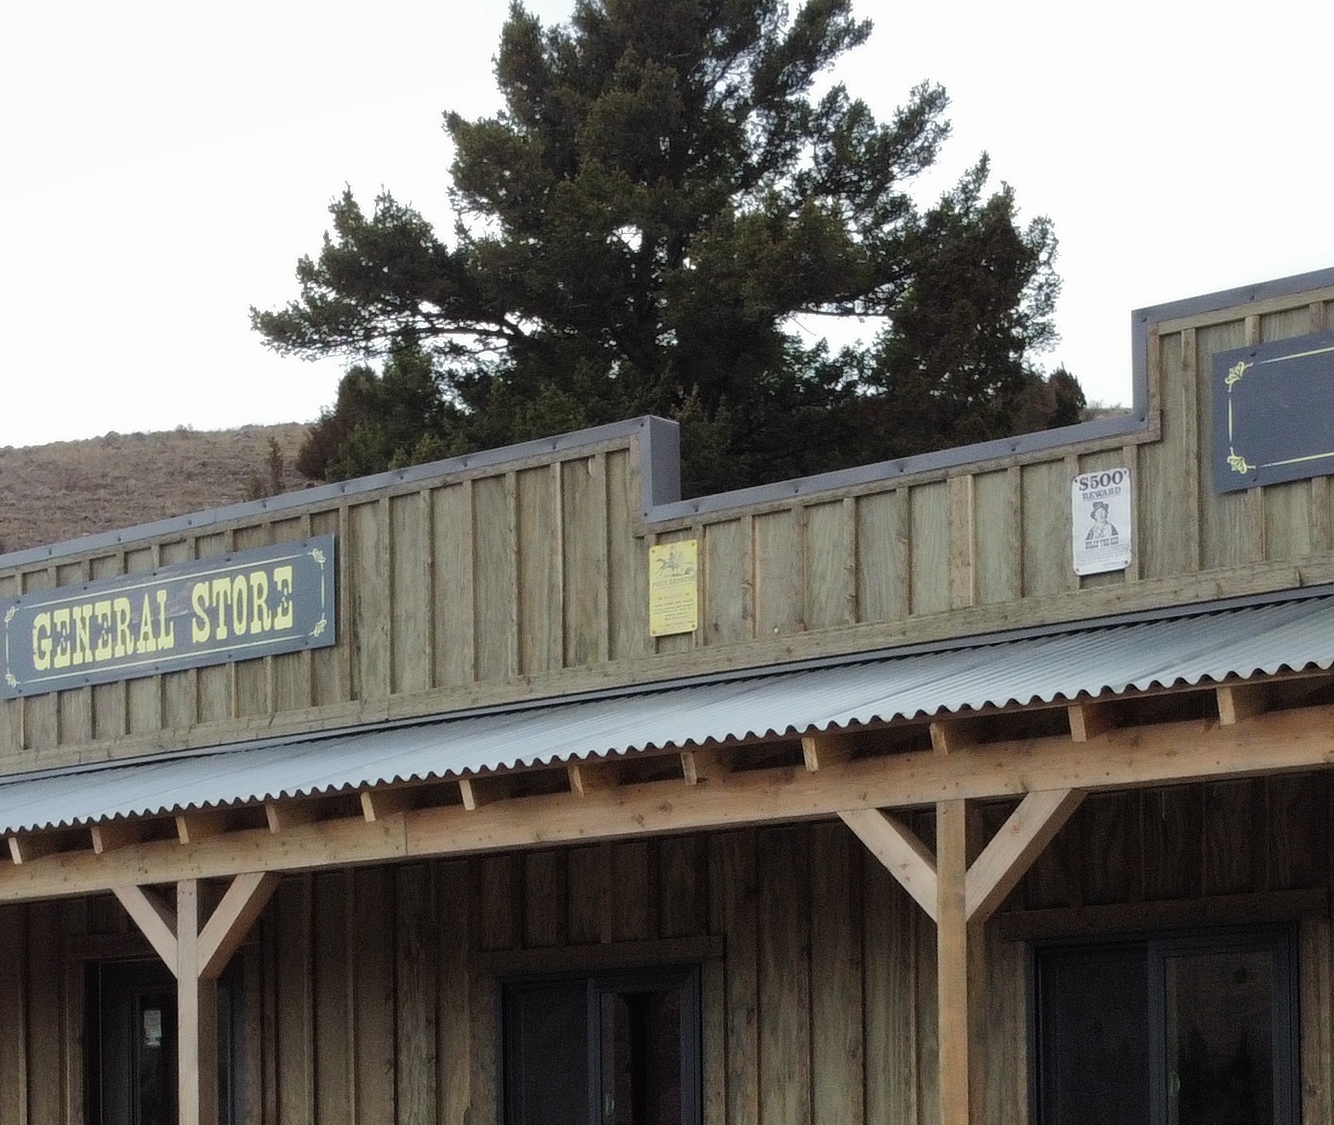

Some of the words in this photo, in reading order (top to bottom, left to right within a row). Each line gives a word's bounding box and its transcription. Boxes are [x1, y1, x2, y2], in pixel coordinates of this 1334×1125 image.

[1082, 486, 1121, 500] REWARD
[31, 589, 175, 671] GENERAL
[191, 565, 294, 644] STORE
